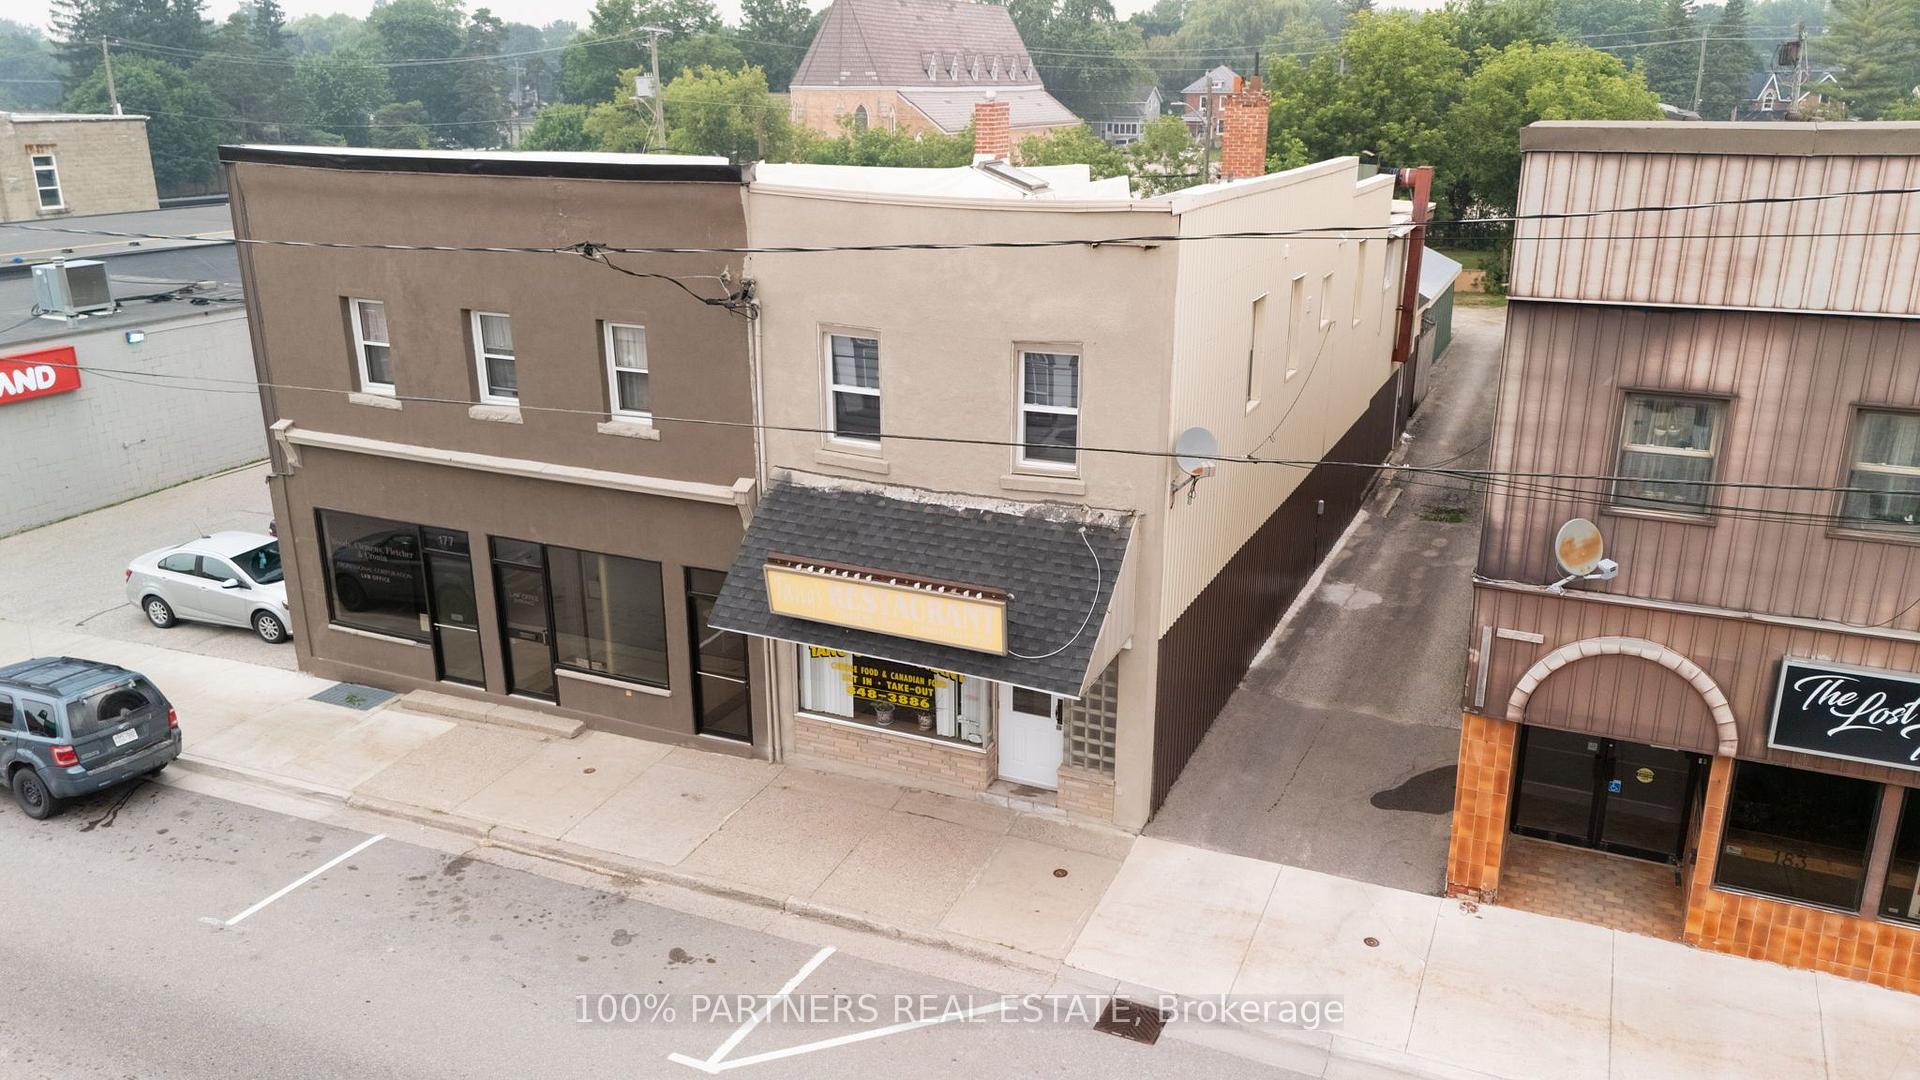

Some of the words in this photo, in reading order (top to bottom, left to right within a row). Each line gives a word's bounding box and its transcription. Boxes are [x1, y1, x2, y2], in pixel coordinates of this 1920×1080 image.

[437, 534, 454, 547] 177
[385, 546, 414, 559] Fletcher
[372, 574, 391, 584] OFFICE
[828, 584, 995, 642] RESTAURANT
[861, 665, 879, 677] FOOD
[881, 670, 888, 679] &
[890, 671, 925, 685] CANADIAN
[847, 685, 930, 709] 848-3886
[862, 676, 872, 686] IN
[886, 681, 935, 697] TAKE-OUT
[1794, 675, 1860, 711] The
[1827, 691, 1920, 737] Lost
[1773, 850, 1808, 871] 183
